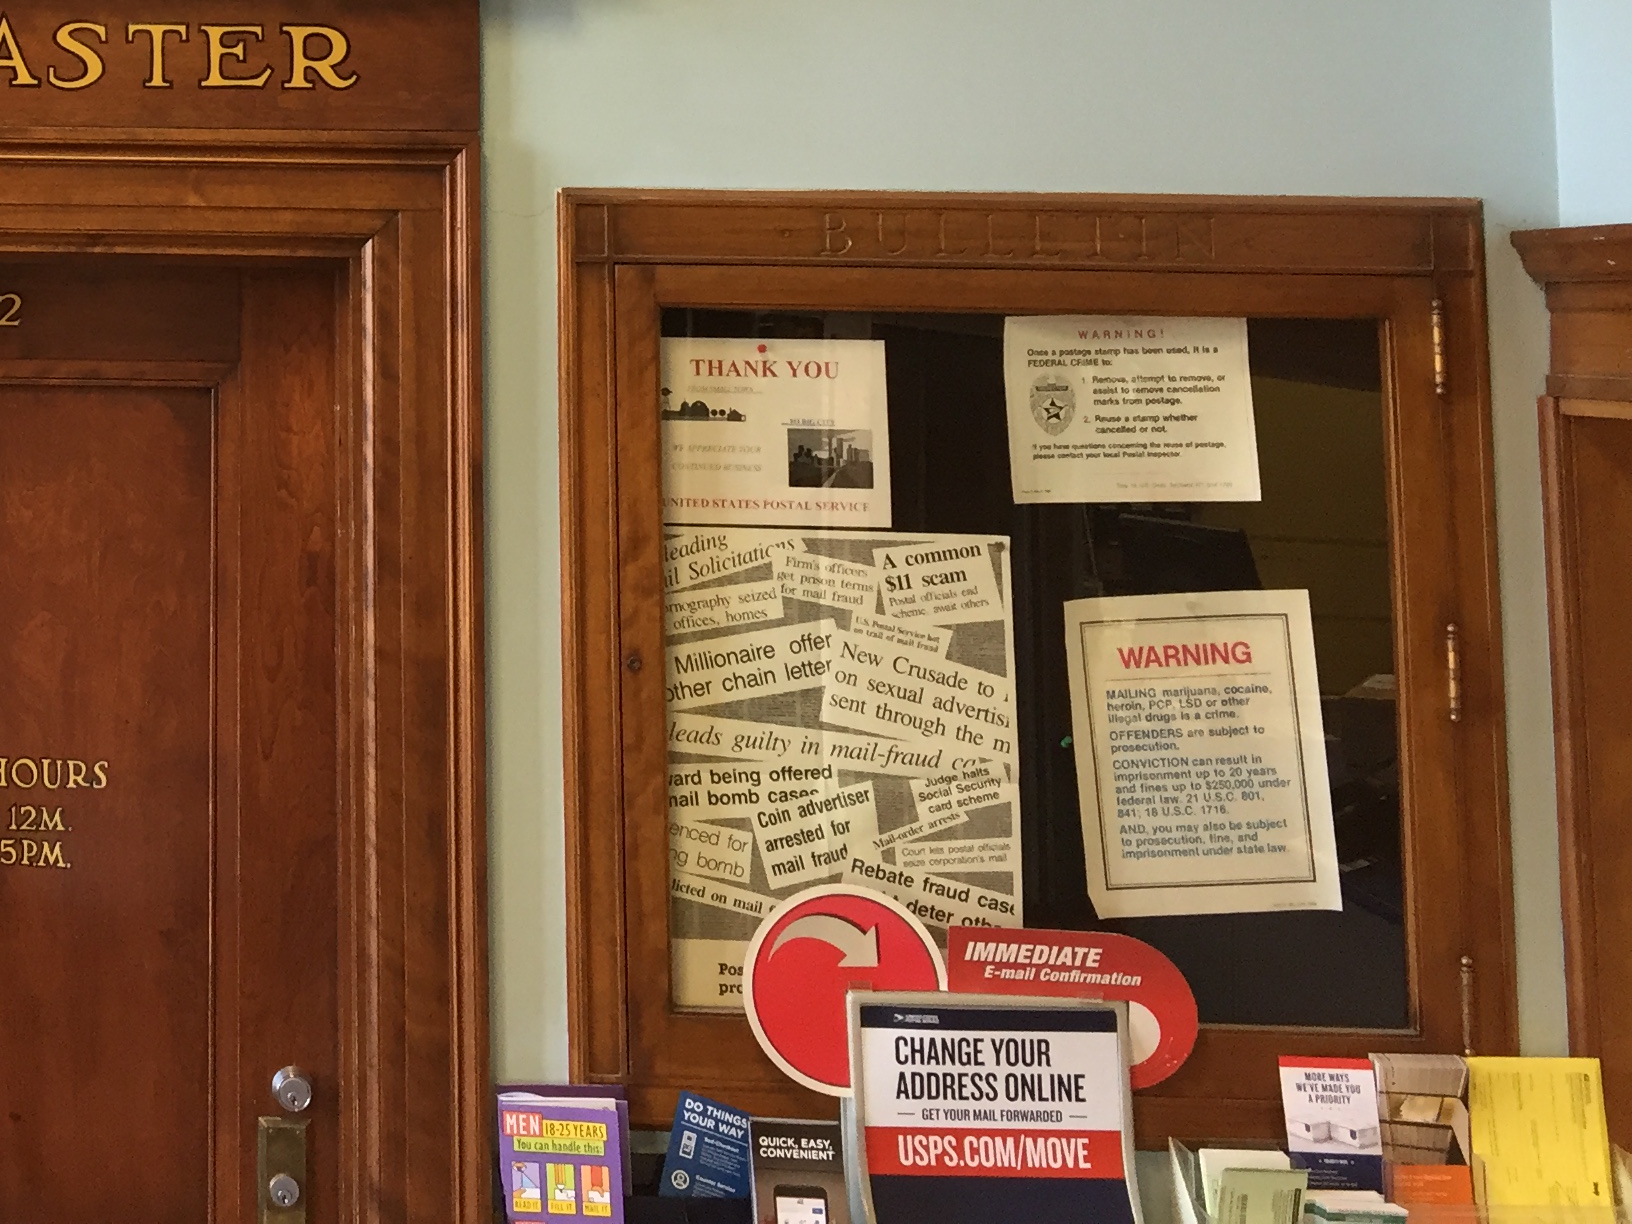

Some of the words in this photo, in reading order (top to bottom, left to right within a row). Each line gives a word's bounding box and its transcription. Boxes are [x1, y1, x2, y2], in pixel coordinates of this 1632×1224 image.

[820, 211, 1217, 262] BULLETIN
[1078, 329, 1165, 340] WARNING!
[689, 359, 779, 379] THANK
[786, 360, 840, 380] YOU
[1027, 359, 1068, 368] FEDERAL
[1070, 358, 1099, 367] CRIME
[712, 498, 759, 510] STATES
[763, 499, 813, 511] POSTAL
[815, 500, 870, 513] SERVICE
[785, 556, 821, 571] Firm's
[825, 561, 868, 577] officers
[883, 553, 897, 571] A
[905, 544, 982, 567] common
[777, 570, 794, 582] get
[800, 574, 836, 589] prison
[840, 579, 875, 593] terms
[884, 574, 913, 593] $11
[921, 570, 967, 588] scam
[738, 587, 777, 604] seized
[780, 583, 797, 596] for
[802, 586, 826, 600] mail
[832, 591, 864, 606] fraud
[673, 613, 721, 630] offices,
[725, 608, 768, 624] homes
[674, 643, 776, 675] Millionaire
[789, 632, 833, 655] offer
[1117, 641, 1252, 670] WARNING
[722, 667, 777, 692] chain
[784, 658, 832, 681] letter
[840, 641, 883, 668] New
[892, 656, 968, 690] Crusade
[977, 680, 995, 698] to
[835, 670, 858, 687] on
[867, 678, 925, 704] sexual
[1106, 688, 1157, 700] MAILING
[1224, 683, 1272, 695] cocaine,
[1107, 700, 1145, 712] heroin,
[1179, 698, 1202, 708] LSD
[1206, 698, 1218, 707] or
[1221, 696, 1250, 706] other
[829, 693, 868, 715] sent
[875, 703, 946, 737] through
[955, 724, 984, 746] the
[1108, 711, 1142, 726] illegal
[1145, 712, 1177, 724] drugs
[1181, 711, 1191, 720] is
[1194, 712, 1201, 720] a
[1205, 710, 1240, 720] crime.
[1110, 728, 1183, 741] OFFENDERS
[1187, 728, 1205, 737] are
[1208, 725, 1249, 738] subject
[1253, 725, 1265, 735] to
[731, 731, 791, 757] guilty
[801, 736, 820, 755] in
[830, 742, 943, 768] mail-fraud
[1111, 742, 1179, 755] prosecution.
[710, 769, 761, 787] being
[769, 764, 833, 782] offered
[925, 774, 958, 788] Judge
[963, 767, 990, 781] halts
[708, 789, 760, 806] bomb
[918, 786, 953, 802] Social
[955, 777, 1001, 795] Security
[757, 808, 792, 829] Coin
[797, 789, 870, 818] advertiser
[928, 801, 953, 814] card
[957, 791, 1000, 808] scheme
[765, 824, 825, 853] arrested
[830, 819, 851, 836] for
[873, 824, 924, 850] Mail-order
[928, 811, 960, 829] arrests
[728, 834, 749, 853] for
[697, 853, 745, 878] bomb
[771, 855, 805, 877] mail
[811, 844, 848, 868] fraud
[851, 858, 914, 888] Rebate
[923, 877, 970, 903] fraud
[711, 892, 727, 904] on
[733, 896, 763, 914] mail
[906, 899, 954, 924] deter
[964, 941, 1103, 968] IMMEDIATE
[984, 965, 1036, 981] E-mail
[1040, 967, 1142, 987] Confirmation
[894, 1035, 986, 1066] CHANGE
[990, 1037, 1052, 1067] YOUR
[896, 1071, 999, 1102] ADDRESS
[1004, 1072, 1087, 1103] ONLINE
[1304, 1072, 1326, 1082] MORE
[1328, 1072, 1350, 1083] WAYS
[1321, 1083, 1343, 1094] MADE
[1345, 1084, 1361, 1094] YOU
[1308, 1094, 1314, 1104] A
[1315, 1094, 1352, 1105] PRIORITY
[684, 1096, 703, 1112] DO
[706, 1102, 748, 1128] THINGS
[921, 1108, 941, 1121] GET
[943, 1108, 971, 1121] YOUR
[973, 1109, 998, 1122] MAIL
[1000, 1109, 1063, 1123] FORWARDED
[504, 1114, 541, 1135] MEN
[544, 1123, 571, 1138] 18-25
[572, 1125, 605, 1139] YEARS
[682, 1109, 717, 1132] YOUR
[719, 1121, 746, 1140] WAY
[515, 1138, 532, 1151] You
[533, 1141, 550, 1152] can
[552, 1140, 581, 1153] handle
[583, 1142, 603, 1154] this:
[759, 1136, 799, 1150] QUICK,
[801, 1138, 833, 1151] EASY,
[759, 1148, 835, 1161] CONVENIENT
[897, 1134, 1092, 1170] USPS.COM/MOVE
